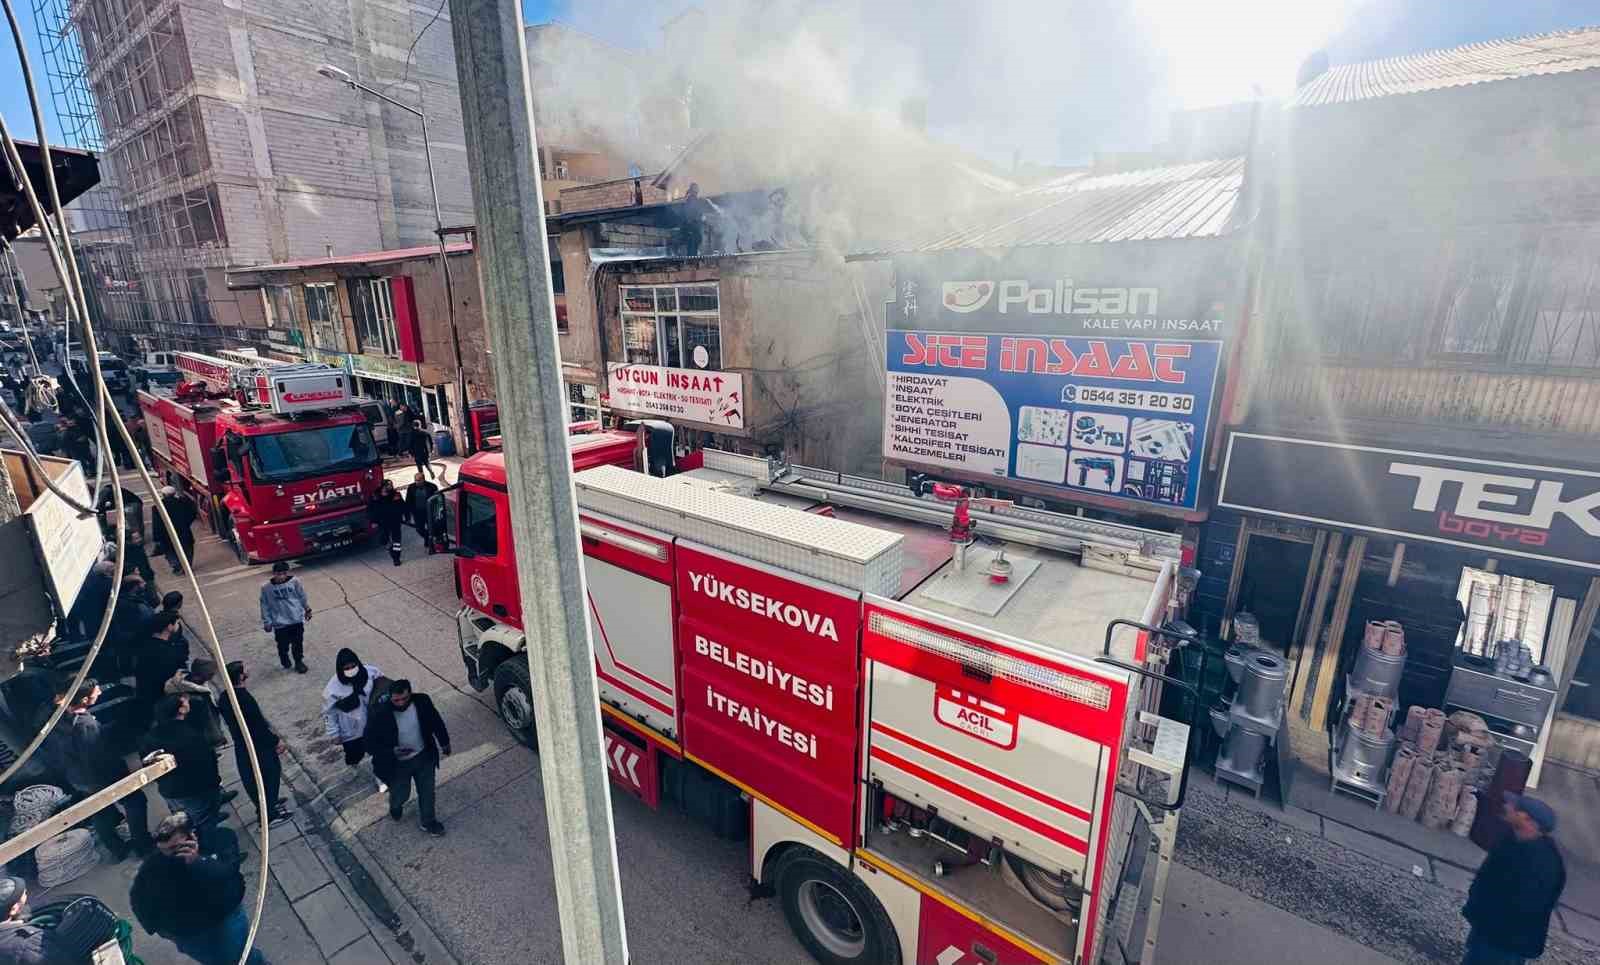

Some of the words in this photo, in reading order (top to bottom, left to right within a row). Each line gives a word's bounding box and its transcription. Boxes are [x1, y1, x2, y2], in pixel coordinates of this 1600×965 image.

[999, 279, 1158, 314] Polisan
[1083, 320, 1119, 329] KALE
[1124, 320, 1157, 329] YAPI
[616, 368, 658, 385] UYGUN
[896, 375, 948, 388] HIRDAVAT
[896, 405, 923, 415] BOYA
[1081, 389, 1114, 402] 0544
[1118, 392, 1143, 406] 351
[1150, 395, 1168, 408] 20
[1172, 397, 1192, 410] 30
[1439, 511, 1548, 545] boya
[688, 570, 839, 642] YÜKSEKOVA
[695, 635, 833, 711] BELEDİYESİ
[707, 685, 817, 759] İTFAİYESİ
